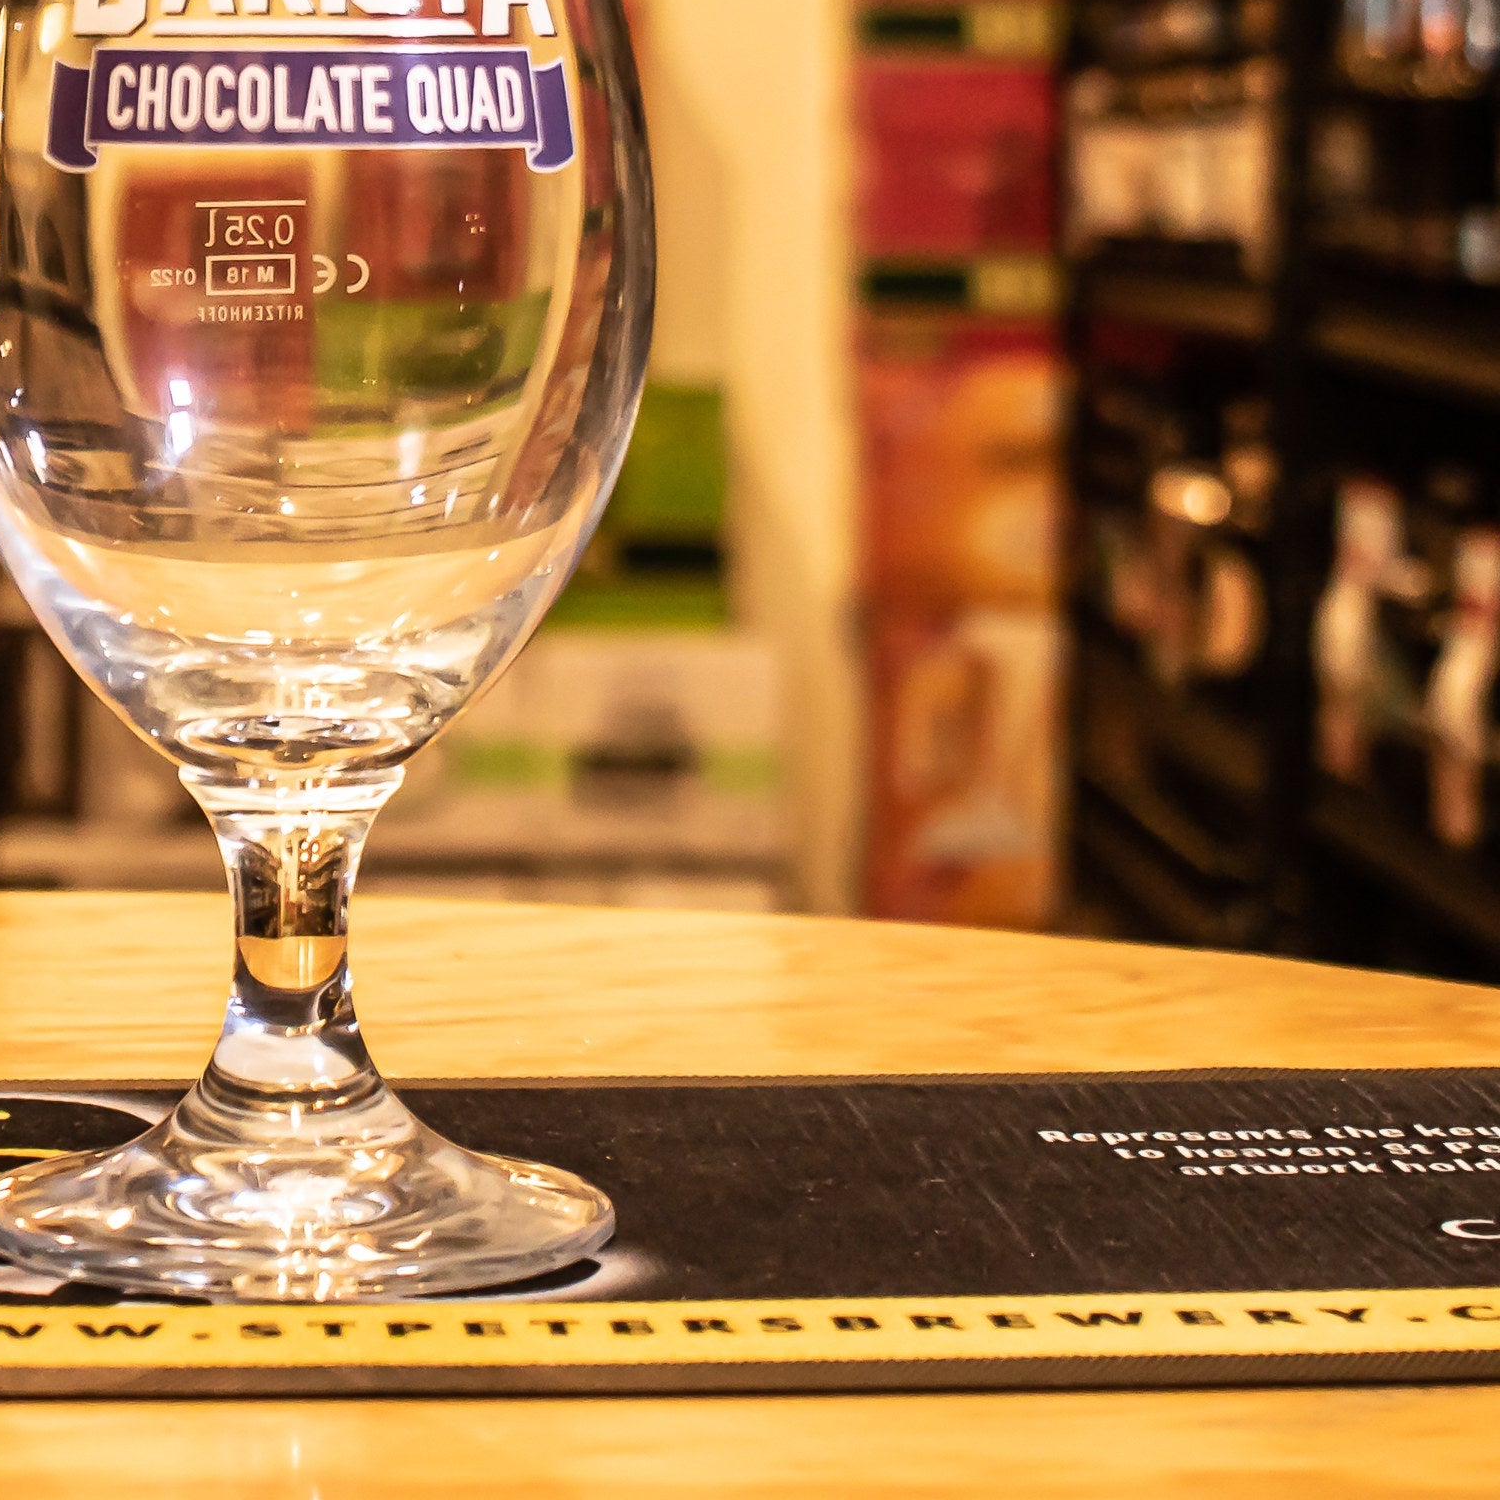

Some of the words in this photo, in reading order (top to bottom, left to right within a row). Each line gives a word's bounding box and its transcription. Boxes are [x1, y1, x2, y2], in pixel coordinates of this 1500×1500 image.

[107, 63, 393, 133] CHOCOLATE
[406, 63, 525, 134] QUAD
[1037, 1128, 1313, 1146] Represents
[1324, 1124, 1406, 1140] the
[1113, 1147, 1166, 1160] to
[1174, 1144, 1373, 1159] heaven.
[1382, 1141, 1435, 1157] St
[1179, 1159, 1384, 1176] artwork
